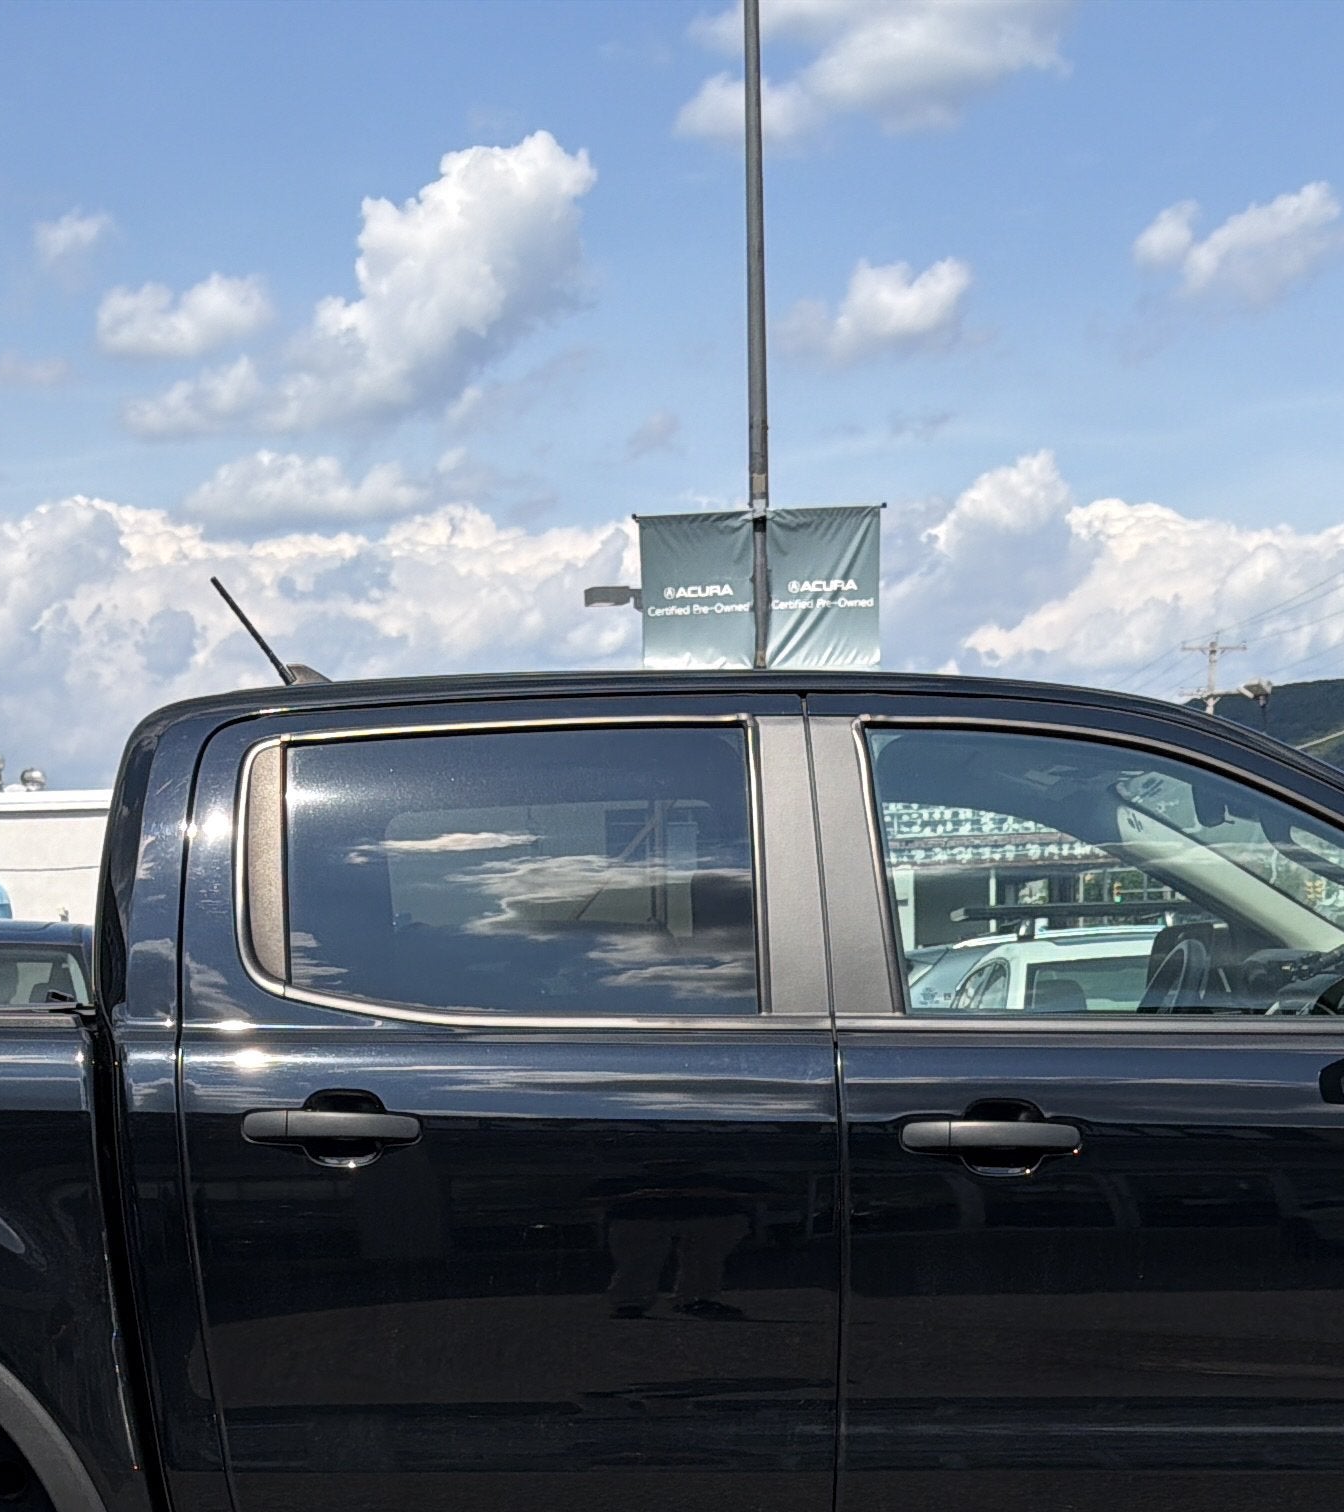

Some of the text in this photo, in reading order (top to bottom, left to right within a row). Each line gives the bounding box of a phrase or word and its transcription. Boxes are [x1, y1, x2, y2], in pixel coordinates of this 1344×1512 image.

[676, 584, 734, 598] ACURA
[800, 579, 858, 592] ACURA
[648, 602, 750, 617] Certified Pre-Owned
[771, 597, 874, 610] Certified Pre-Owned
